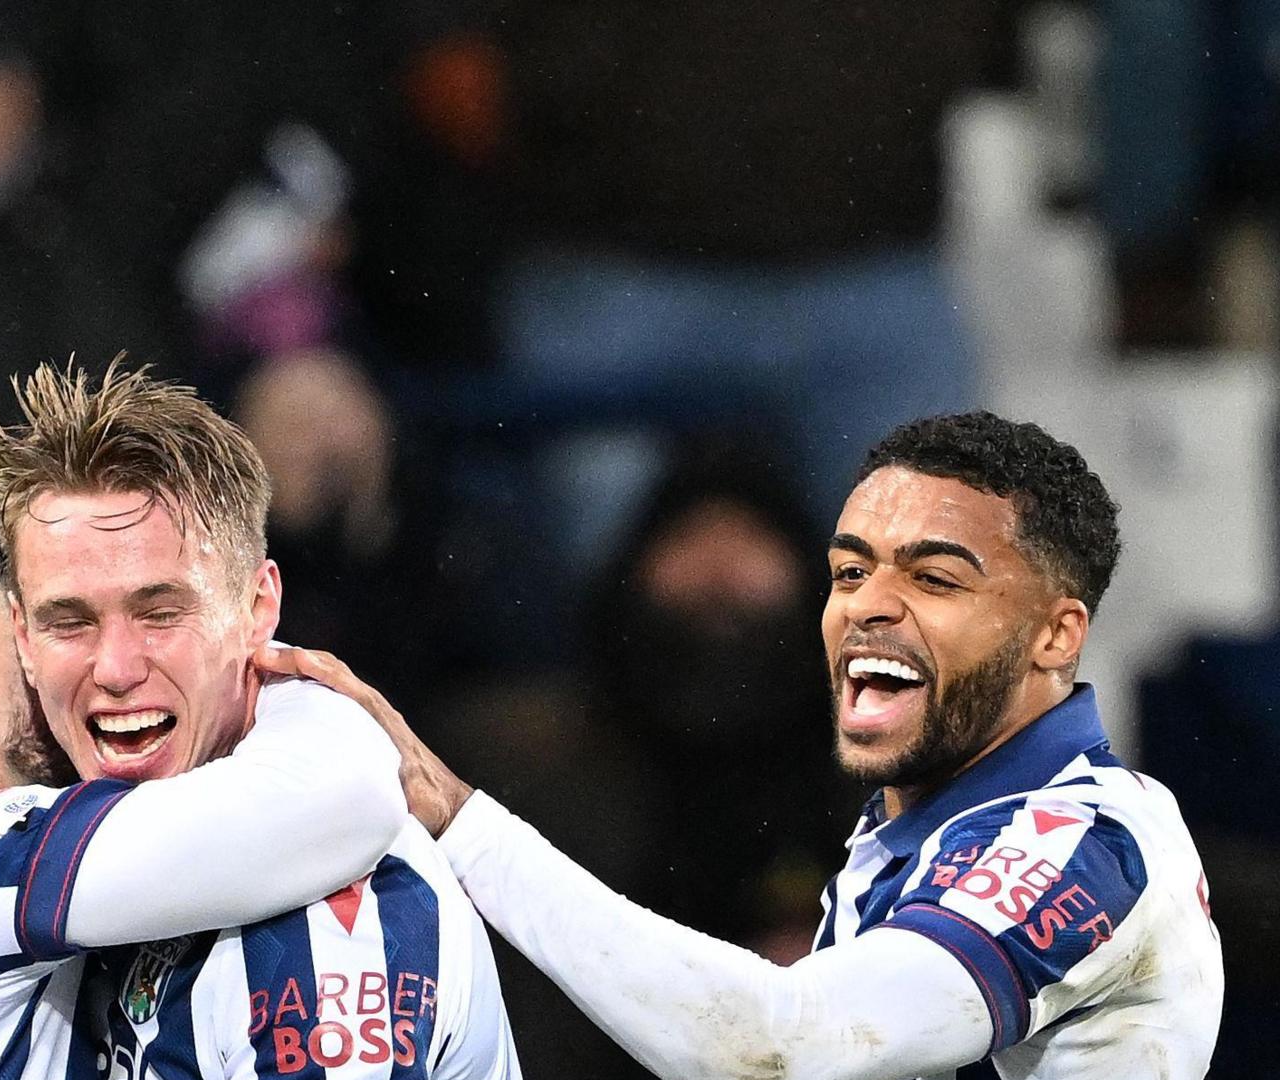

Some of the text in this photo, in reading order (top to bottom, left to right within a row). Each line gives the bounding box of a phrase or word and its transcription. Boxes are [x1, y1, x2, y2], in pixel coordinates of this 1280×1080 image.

[944, 845, 1114, 955] RBER
[248, 971, 438, 1038] BARBER
[272, 1018, 416, 1074] BOSS
